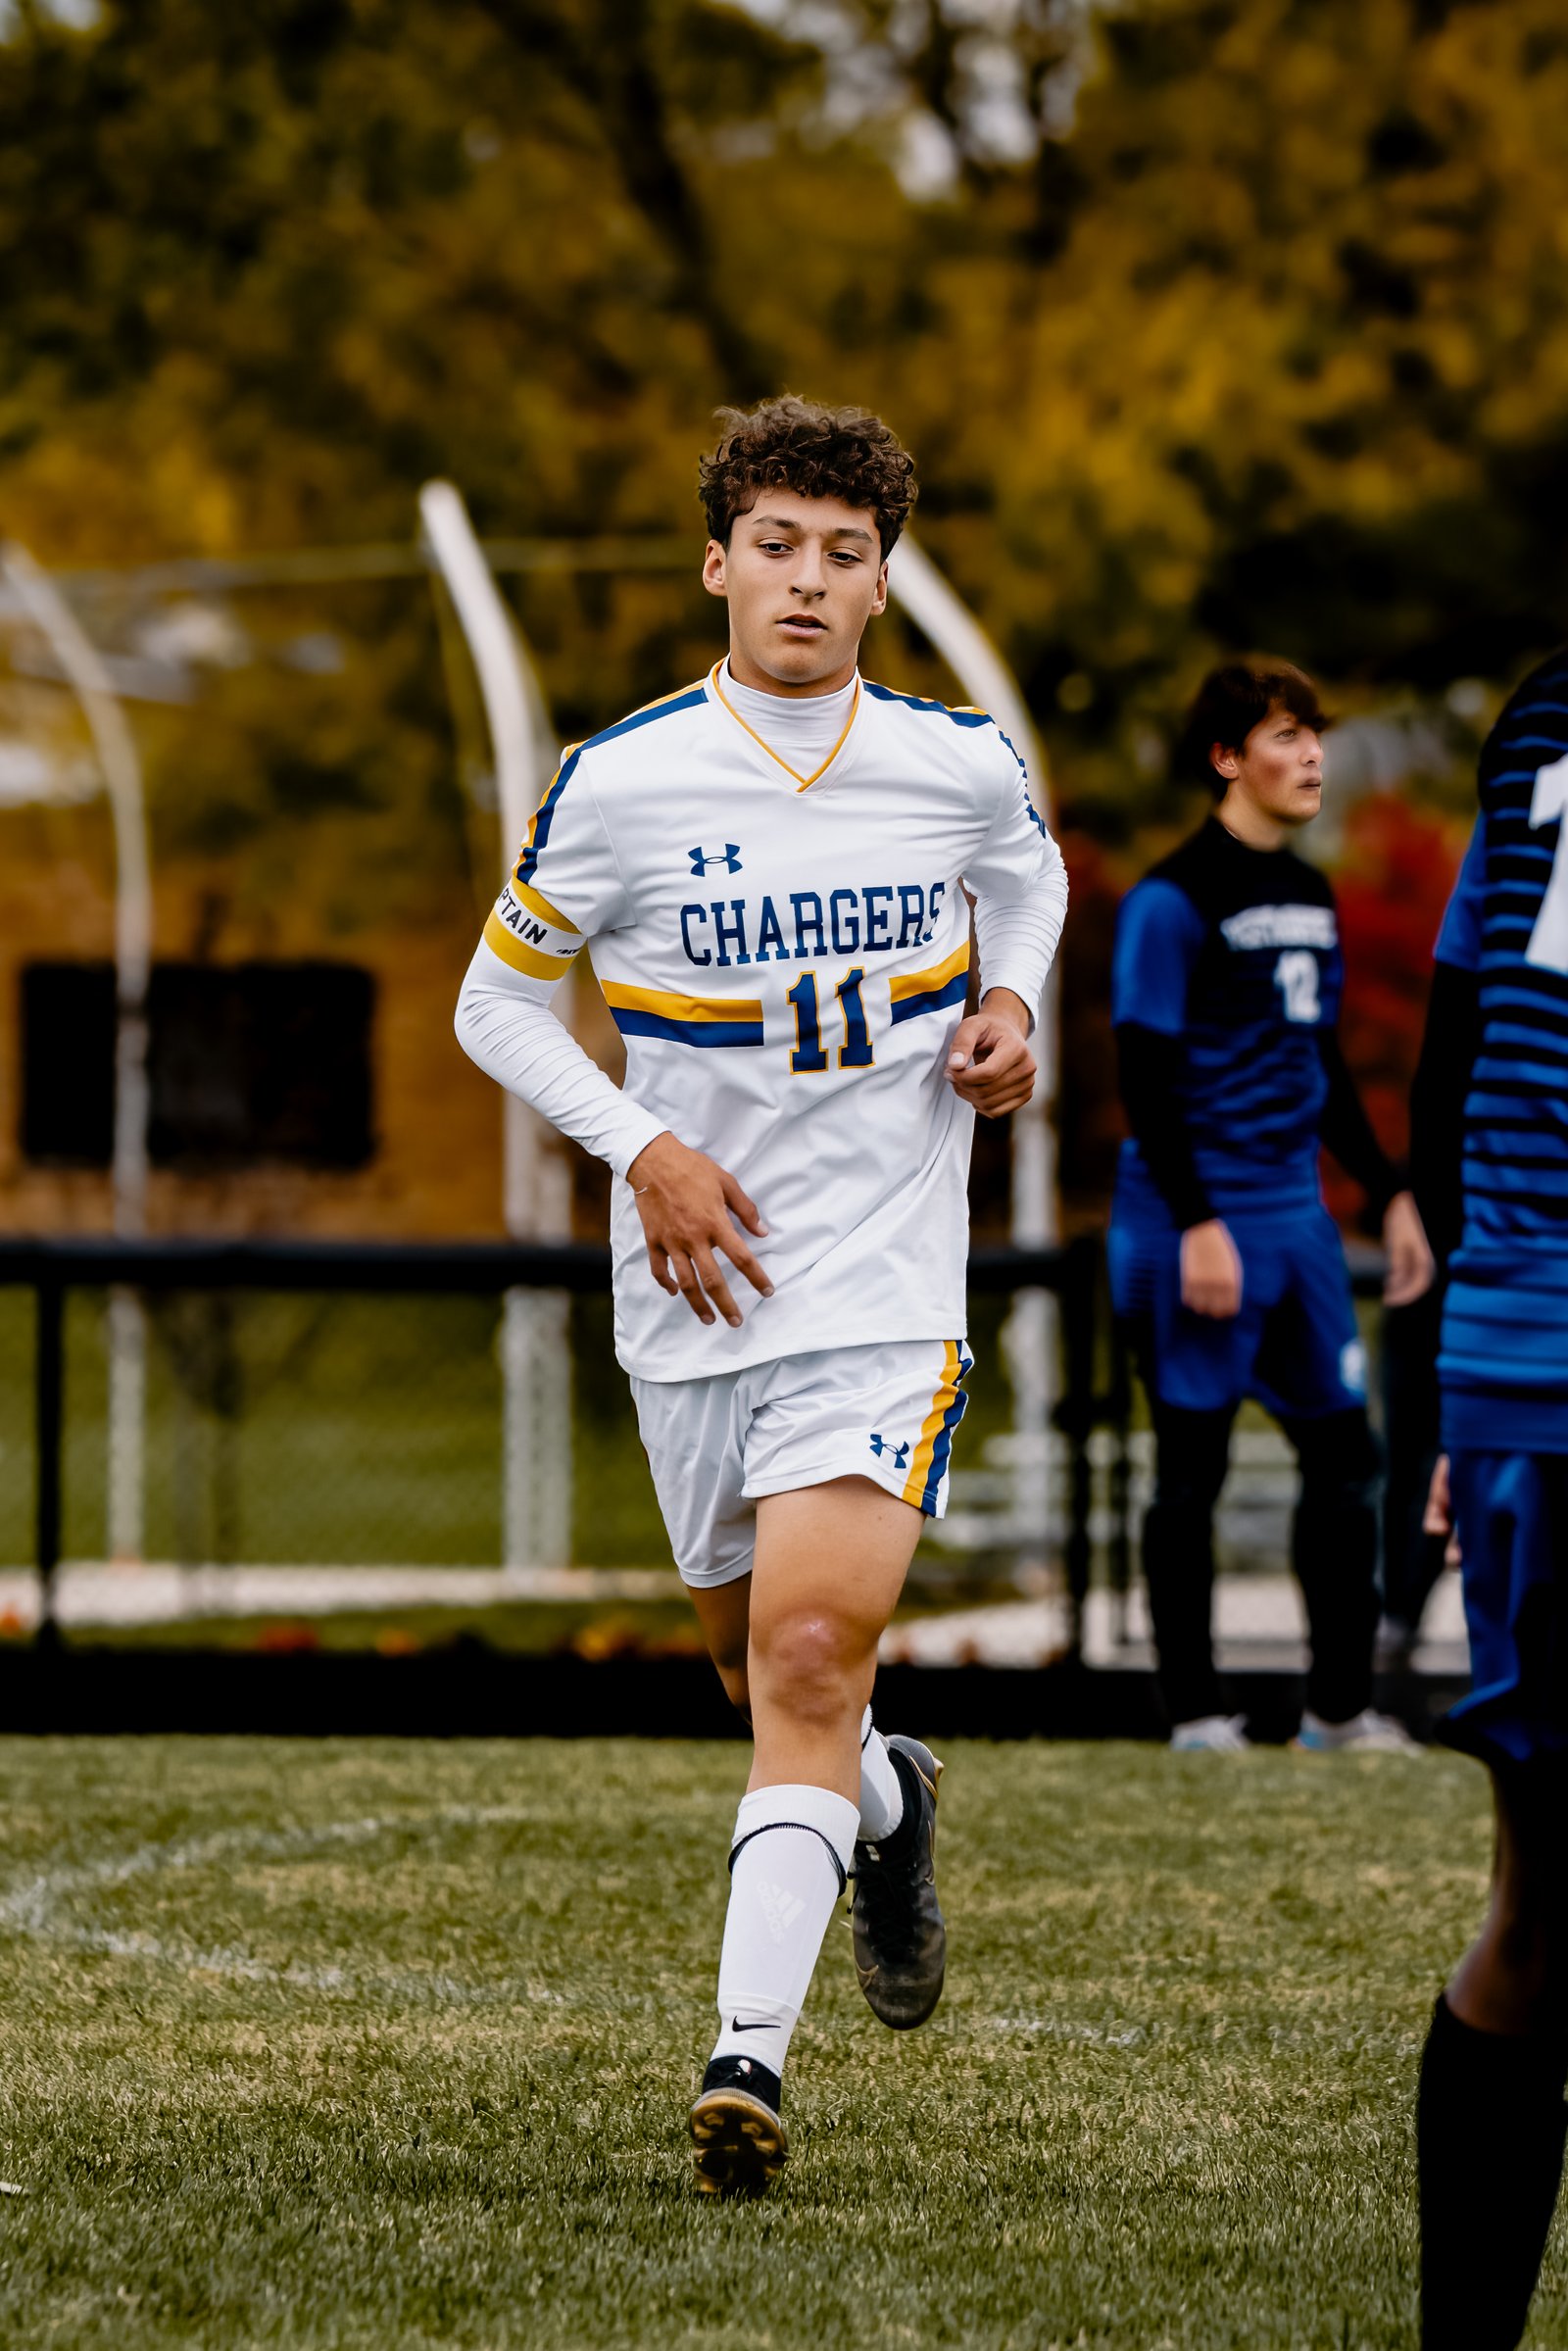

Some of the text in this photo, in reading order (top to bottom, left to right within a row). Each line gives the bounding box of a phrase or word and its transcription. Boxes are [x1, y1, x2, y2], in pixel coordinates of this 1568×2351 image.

[680, 881, 946, 967] CHARGERS
[786, 965, 876, 1076] 11
[756, 1881, 785, 1943] adidas
